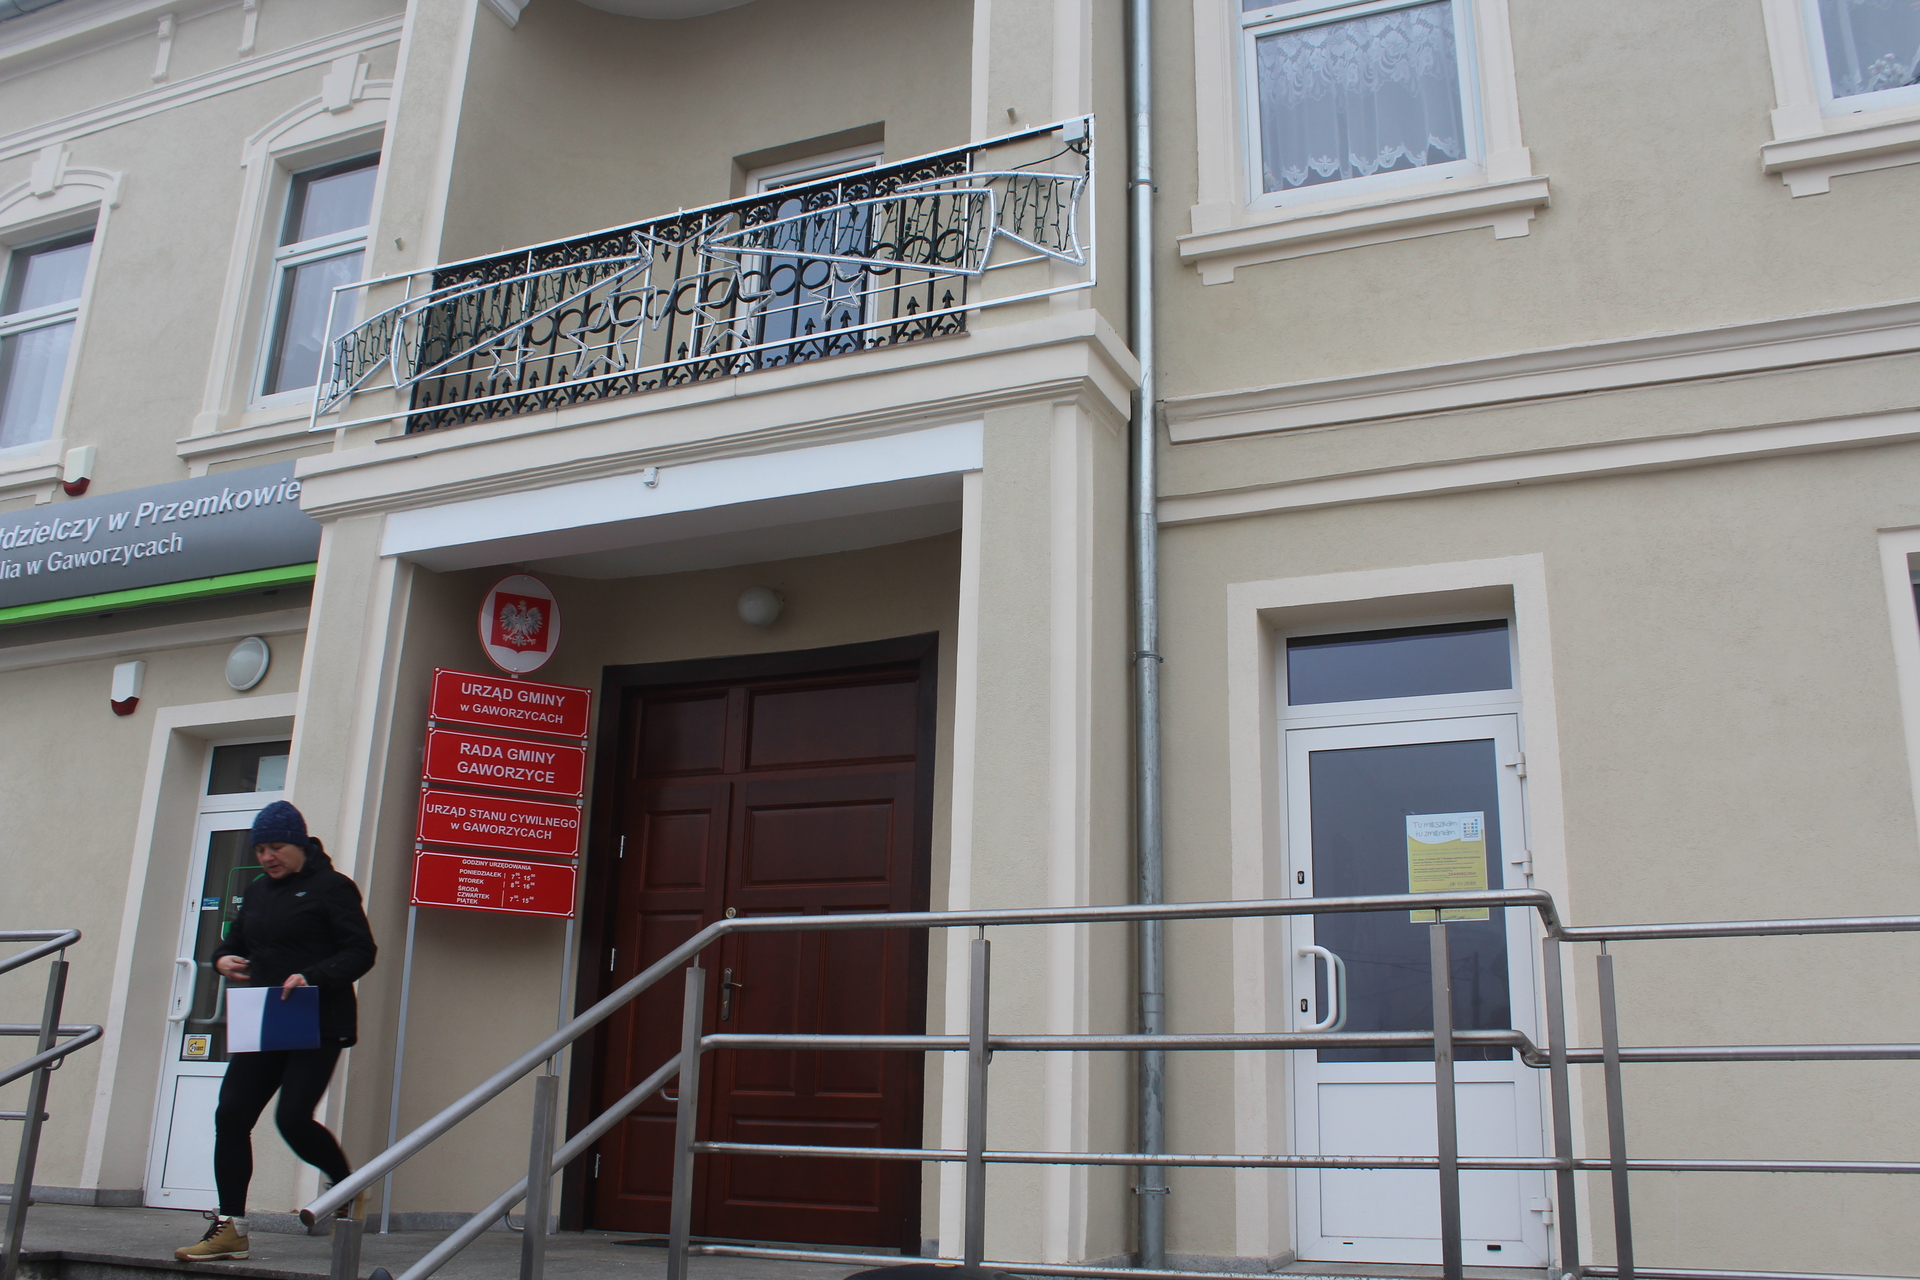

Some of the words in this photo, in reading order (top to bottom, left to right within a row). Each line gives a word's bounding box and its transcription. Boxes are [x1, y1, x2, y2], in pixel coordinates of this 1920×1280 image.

[108, 510, 131, 531] w
[134, 478, 300, 527] Przemkowie
[0, 560, 21, 579] lia
[27, 560, 44, 575] w
[47, 532, 183, 572] Gaworzycach
[461, 682, 513, 701] URZĄD
[517, 690, 566, 707] GMINY
[472, 703, 564, 724] GAWORZYCACH
[460, 742, 504, 759] RADA
[507, 748, 556, 765] GMINY
[457, 761, 555, 784] GAWORZYCE
[426, 803, 467, 818] URZĄD
[469, 809, 507, 822] STANU
[510, 813, 577, 829] CYWILNEGO
[450, 822, 460, 830] w
[463, 821, 552, 840] GAWORZYCACH
[459, 869, 502, 877] PONIEDZIAŁEK
[489, 862, 531, 870] URZĘDOWANIA
